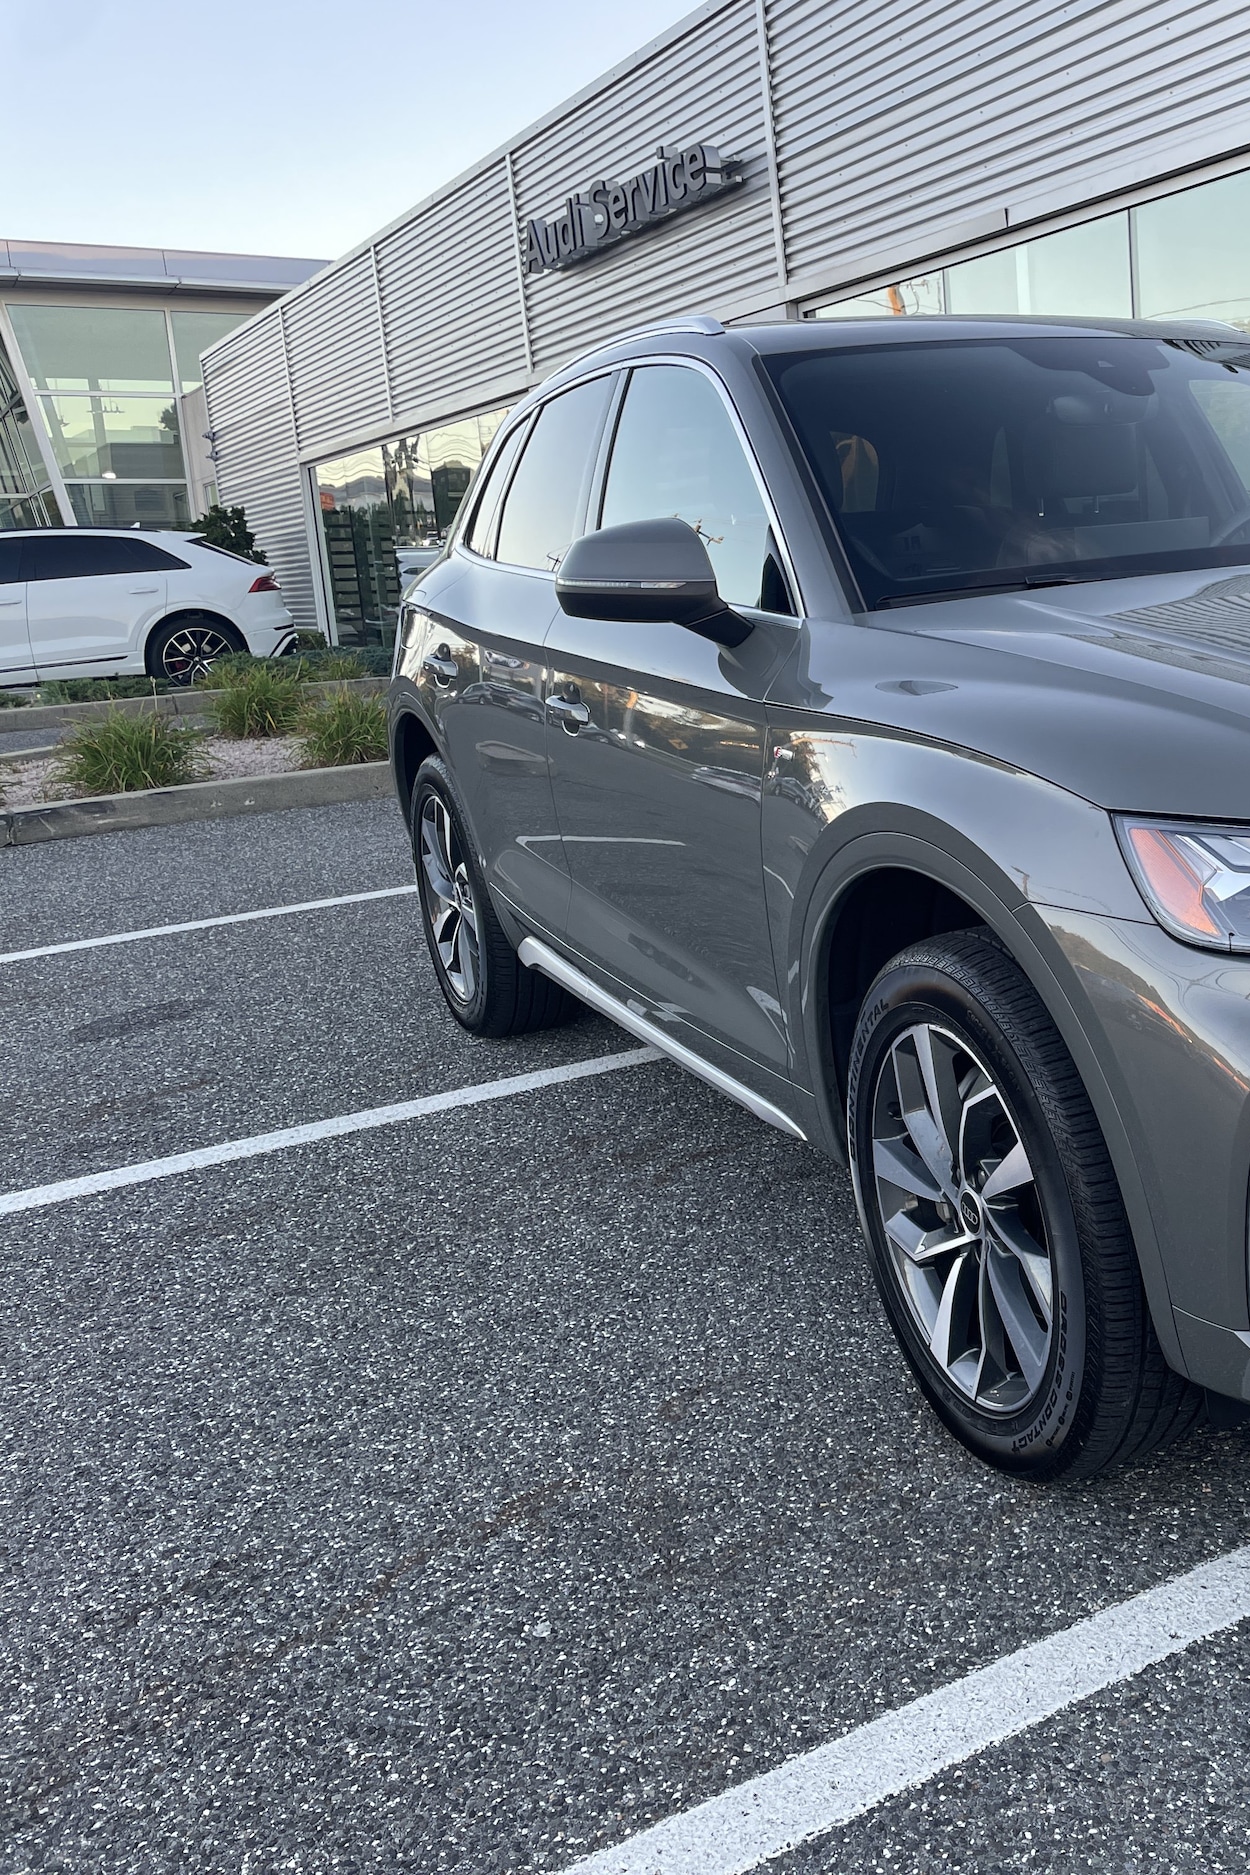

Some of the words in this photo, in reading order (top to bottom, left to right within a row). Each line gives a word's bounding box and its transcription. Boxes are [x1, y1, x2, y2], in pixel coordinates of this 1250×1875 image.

[525, 193, 587, 273] Audi
[589, 144, 707, 241] Service
[847, 998, 890, 1162] CONTINENTAL
